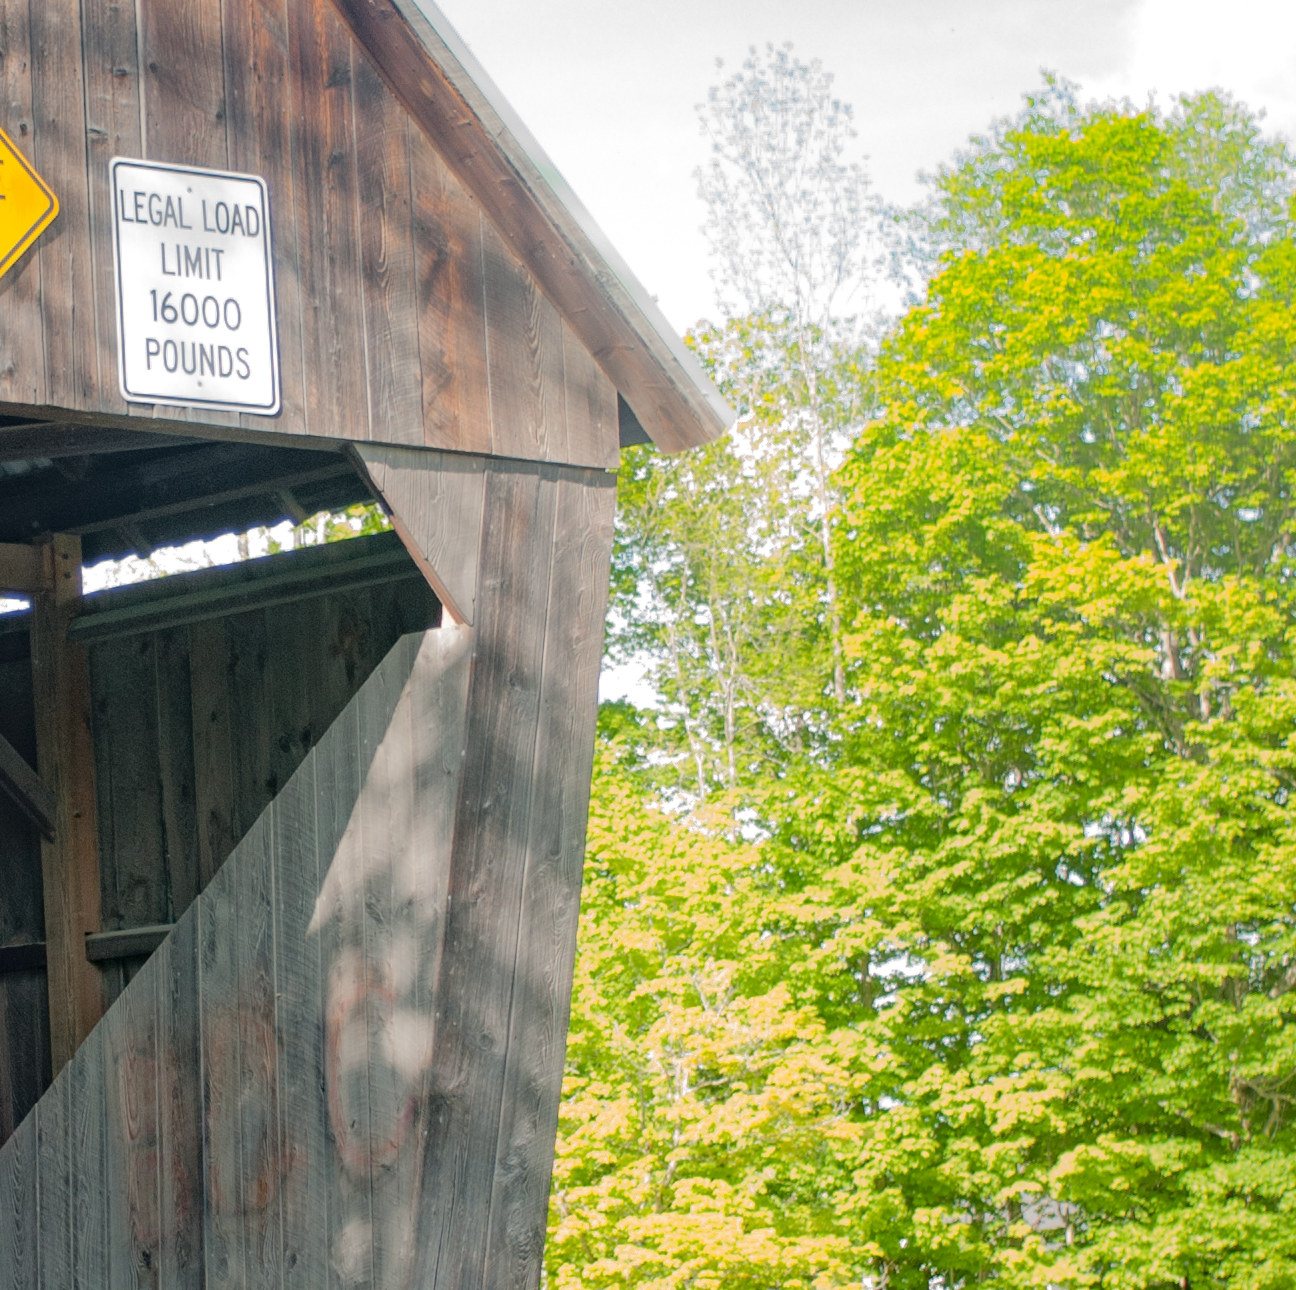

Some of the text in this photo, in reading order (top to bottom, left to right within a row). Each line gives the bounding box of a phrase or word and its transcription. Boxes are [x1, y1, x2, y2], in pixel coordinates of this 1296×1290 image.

[120, 188, 260, 238] LEGAL LOAD
[160, 242, 225, 281] LIMIT
[150, 289, 242, 331] 16000
[145, 337, 251, 380] POUNDS
